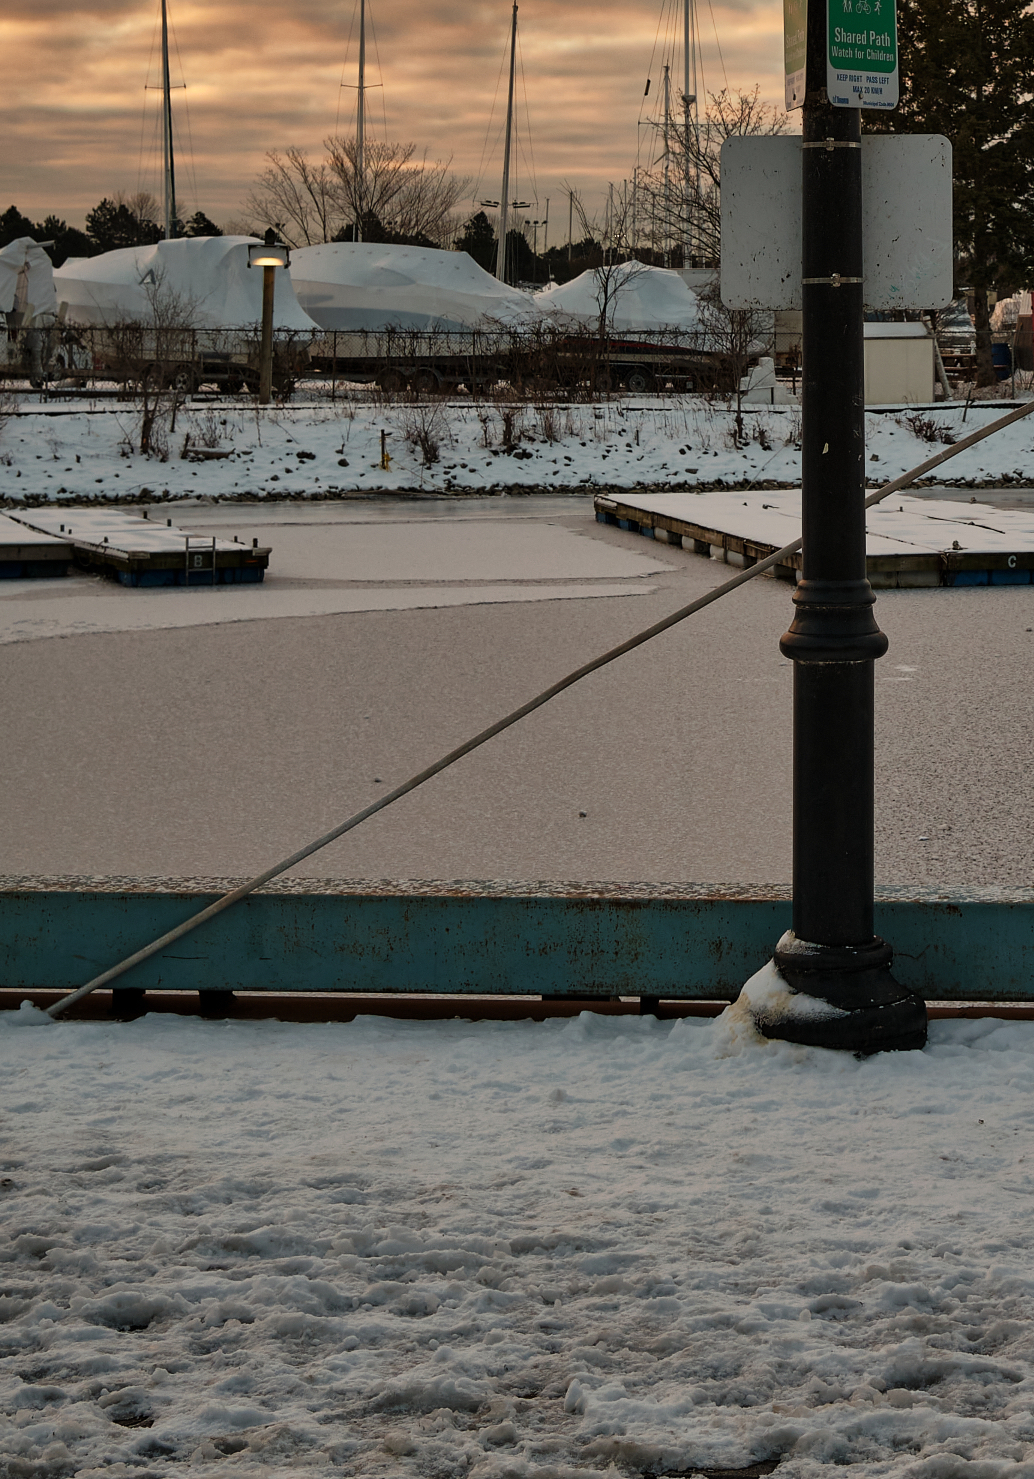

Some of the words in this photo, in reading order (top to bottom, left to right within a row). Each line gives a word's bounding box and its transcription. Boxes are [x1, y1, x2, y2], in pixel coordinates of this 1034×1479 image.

[834, 27, 867, 46] Shared
[869, 30, 891, 48] Path
[831, 45, 853, 59] Watch
[855, 47, 865, 60] for
[866, 48, 894, 62] Children
[837, 73, 848, 81] KEEP
[849, 74, 862, 82] RIGHT
[866, 75, 878, 84] PASS
[879, 76, 889, 84] LEFT
[853, 85, 863, 93] MAX
[864, 86, 870, 94] 20
[194, 555, 203, 567] B
[1007, 555, 1017, 568] C
